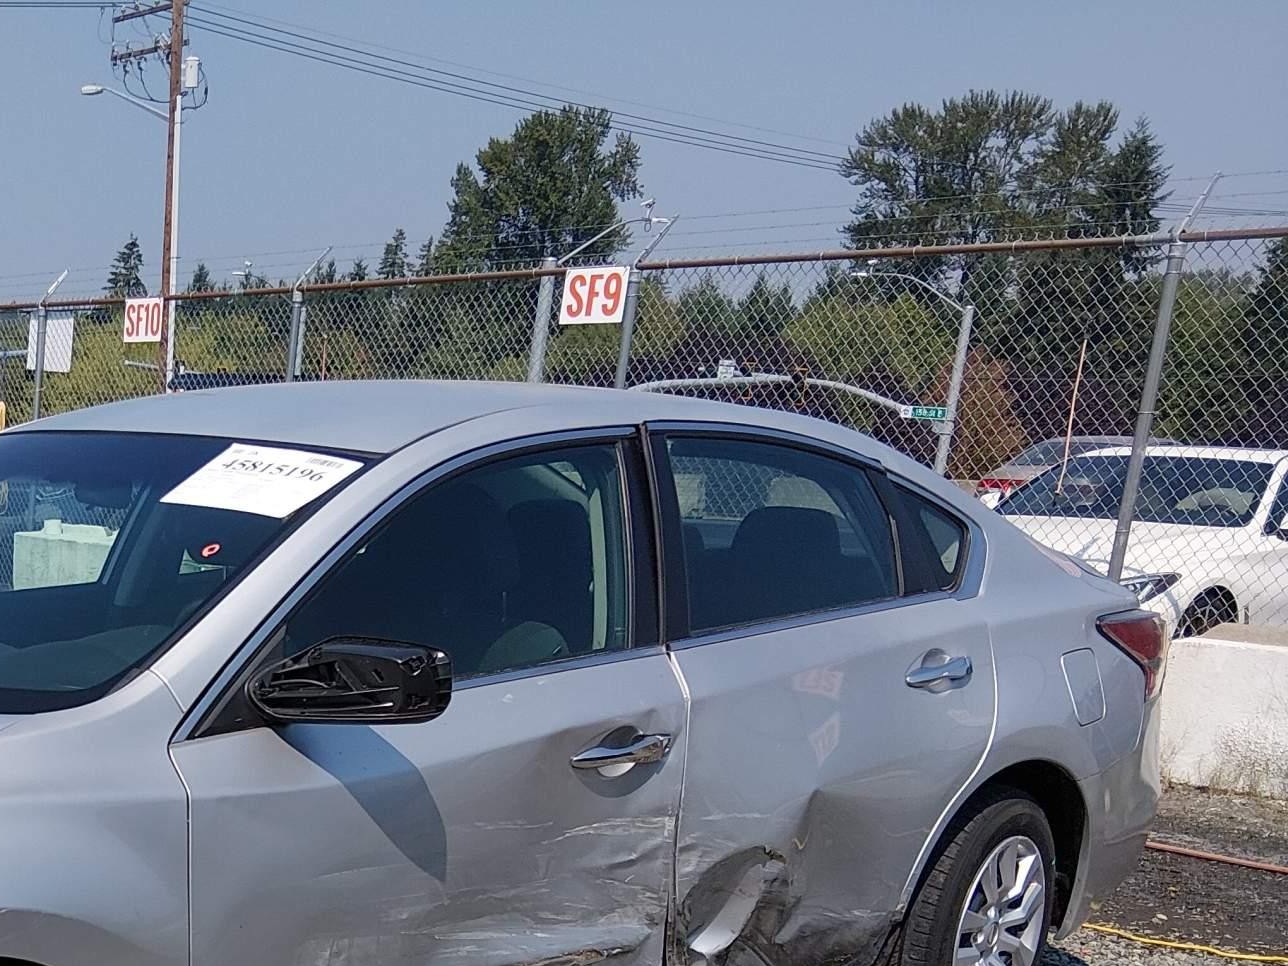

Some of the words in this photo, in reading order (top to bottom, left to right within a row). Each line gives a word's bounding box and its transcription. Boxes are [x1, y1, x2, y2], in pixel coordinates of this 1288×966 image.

[566, 271, 623, 318] SF9
[125, 302, 160, 338] SF10
[221, 458, 327, 482] 45815196
